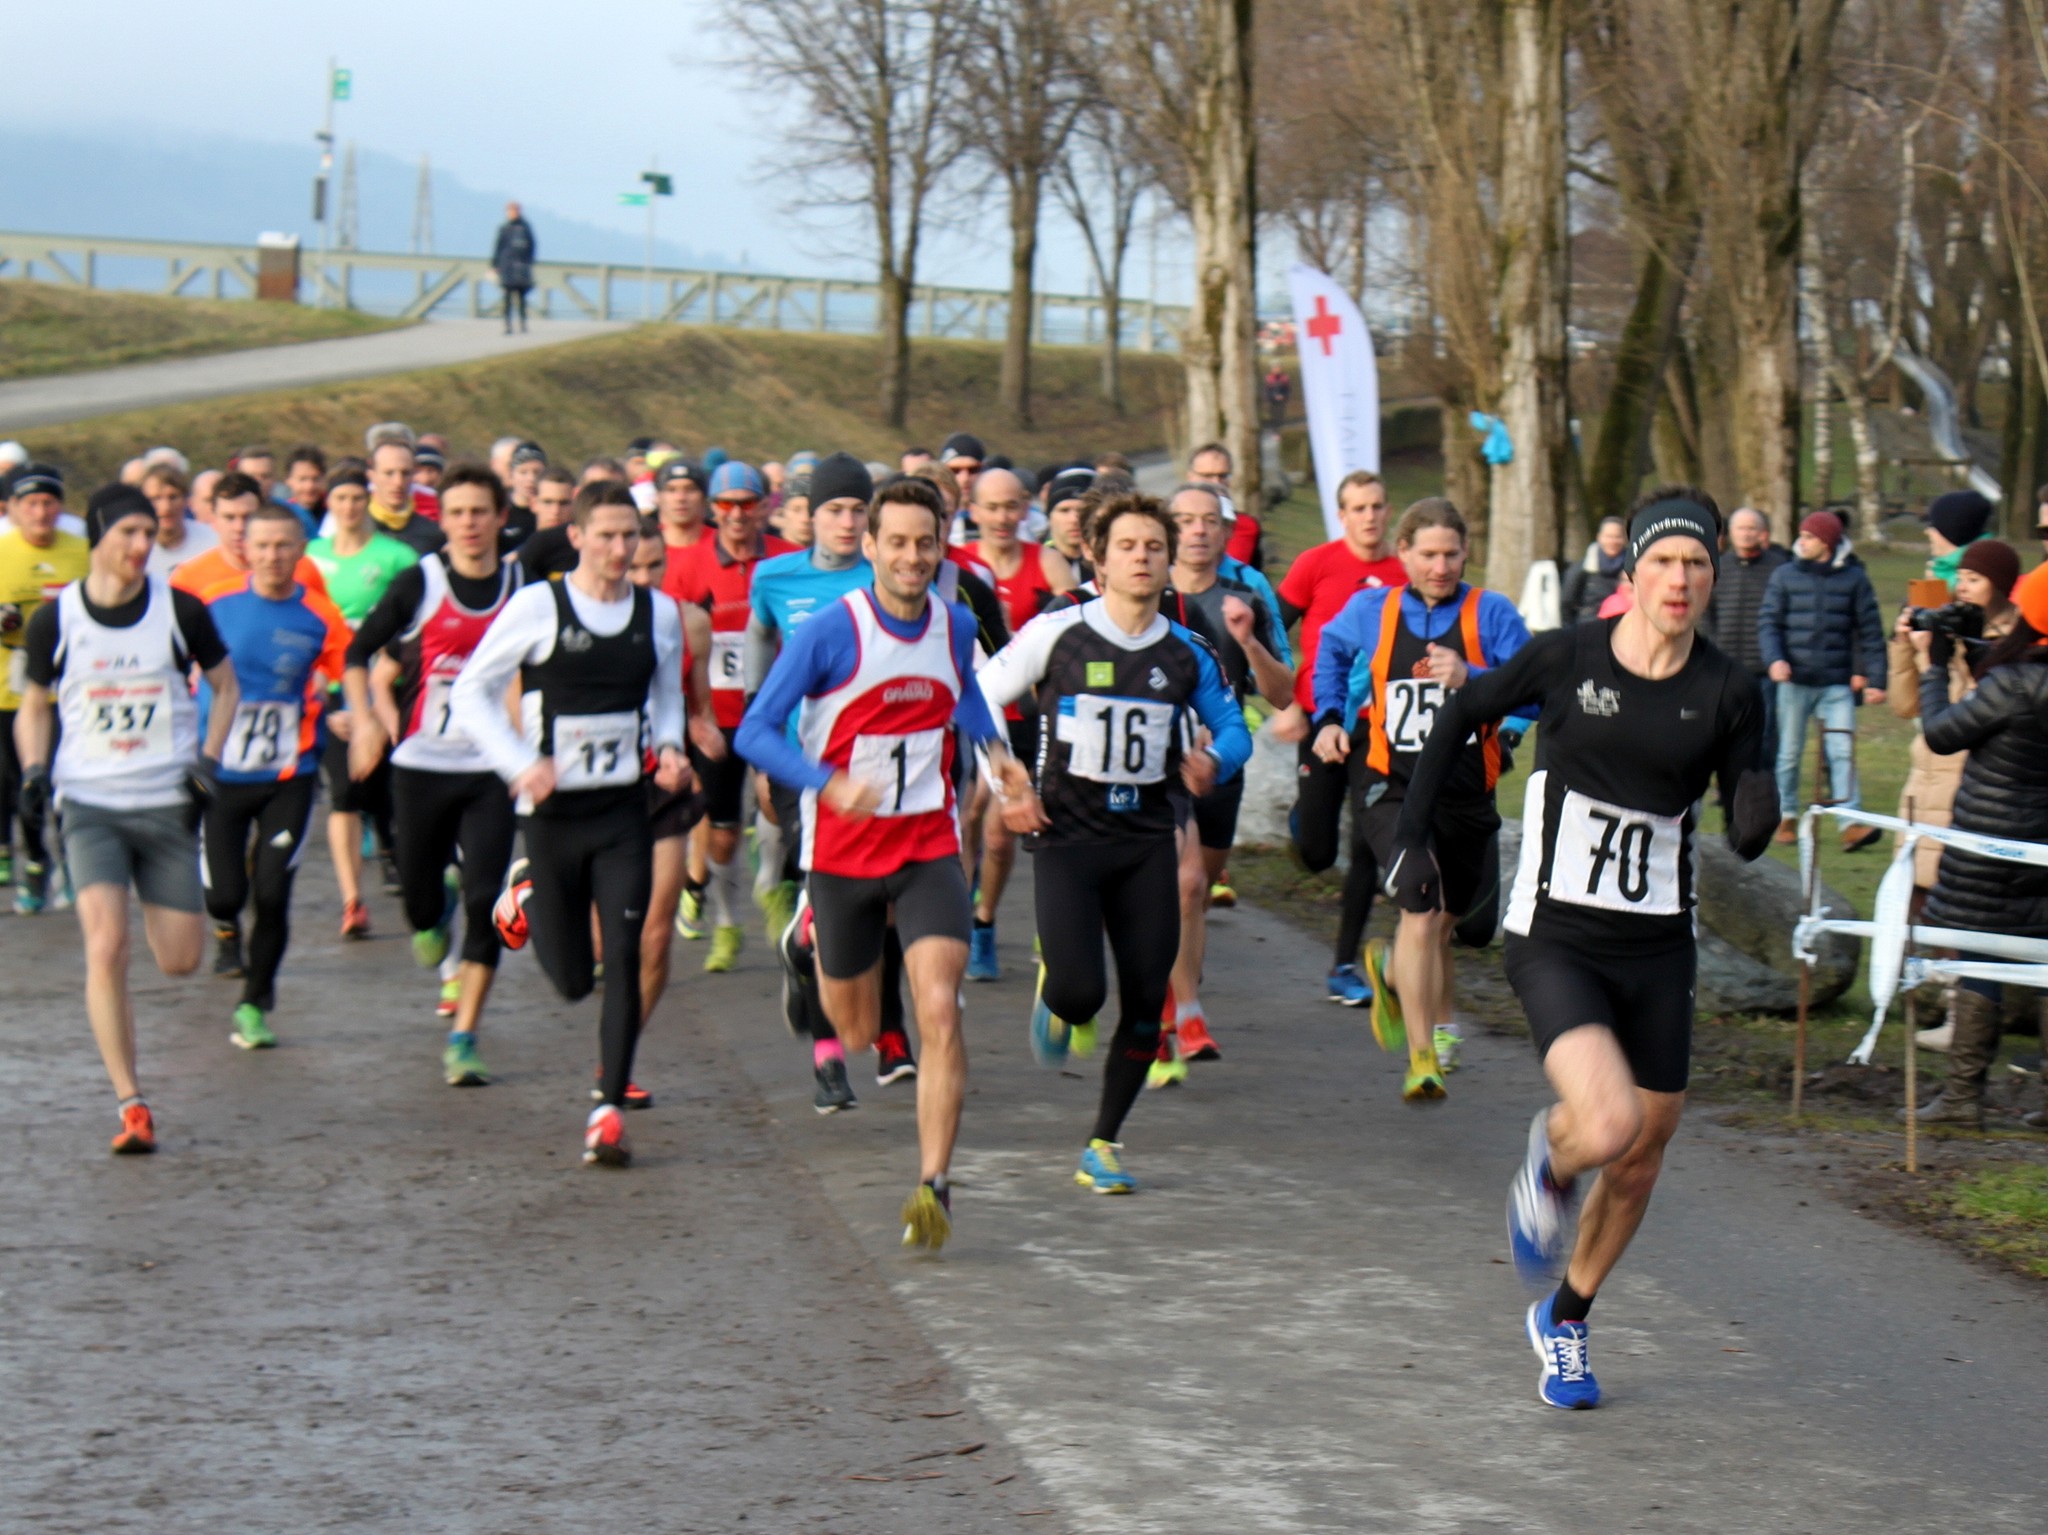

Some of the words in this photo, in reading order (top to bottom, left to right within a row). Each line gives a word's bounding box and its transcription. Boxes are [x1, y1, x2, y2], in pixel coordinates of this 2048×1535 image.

[722, 650, 737, 677] 6
[97, 703, 158, 732] 537
[1096, 705, 1148, 774] 16
[580, 740, 621, 774] 13
[889, 738, 906, 812] 1
[1585, 806, 1655, 902] 70
